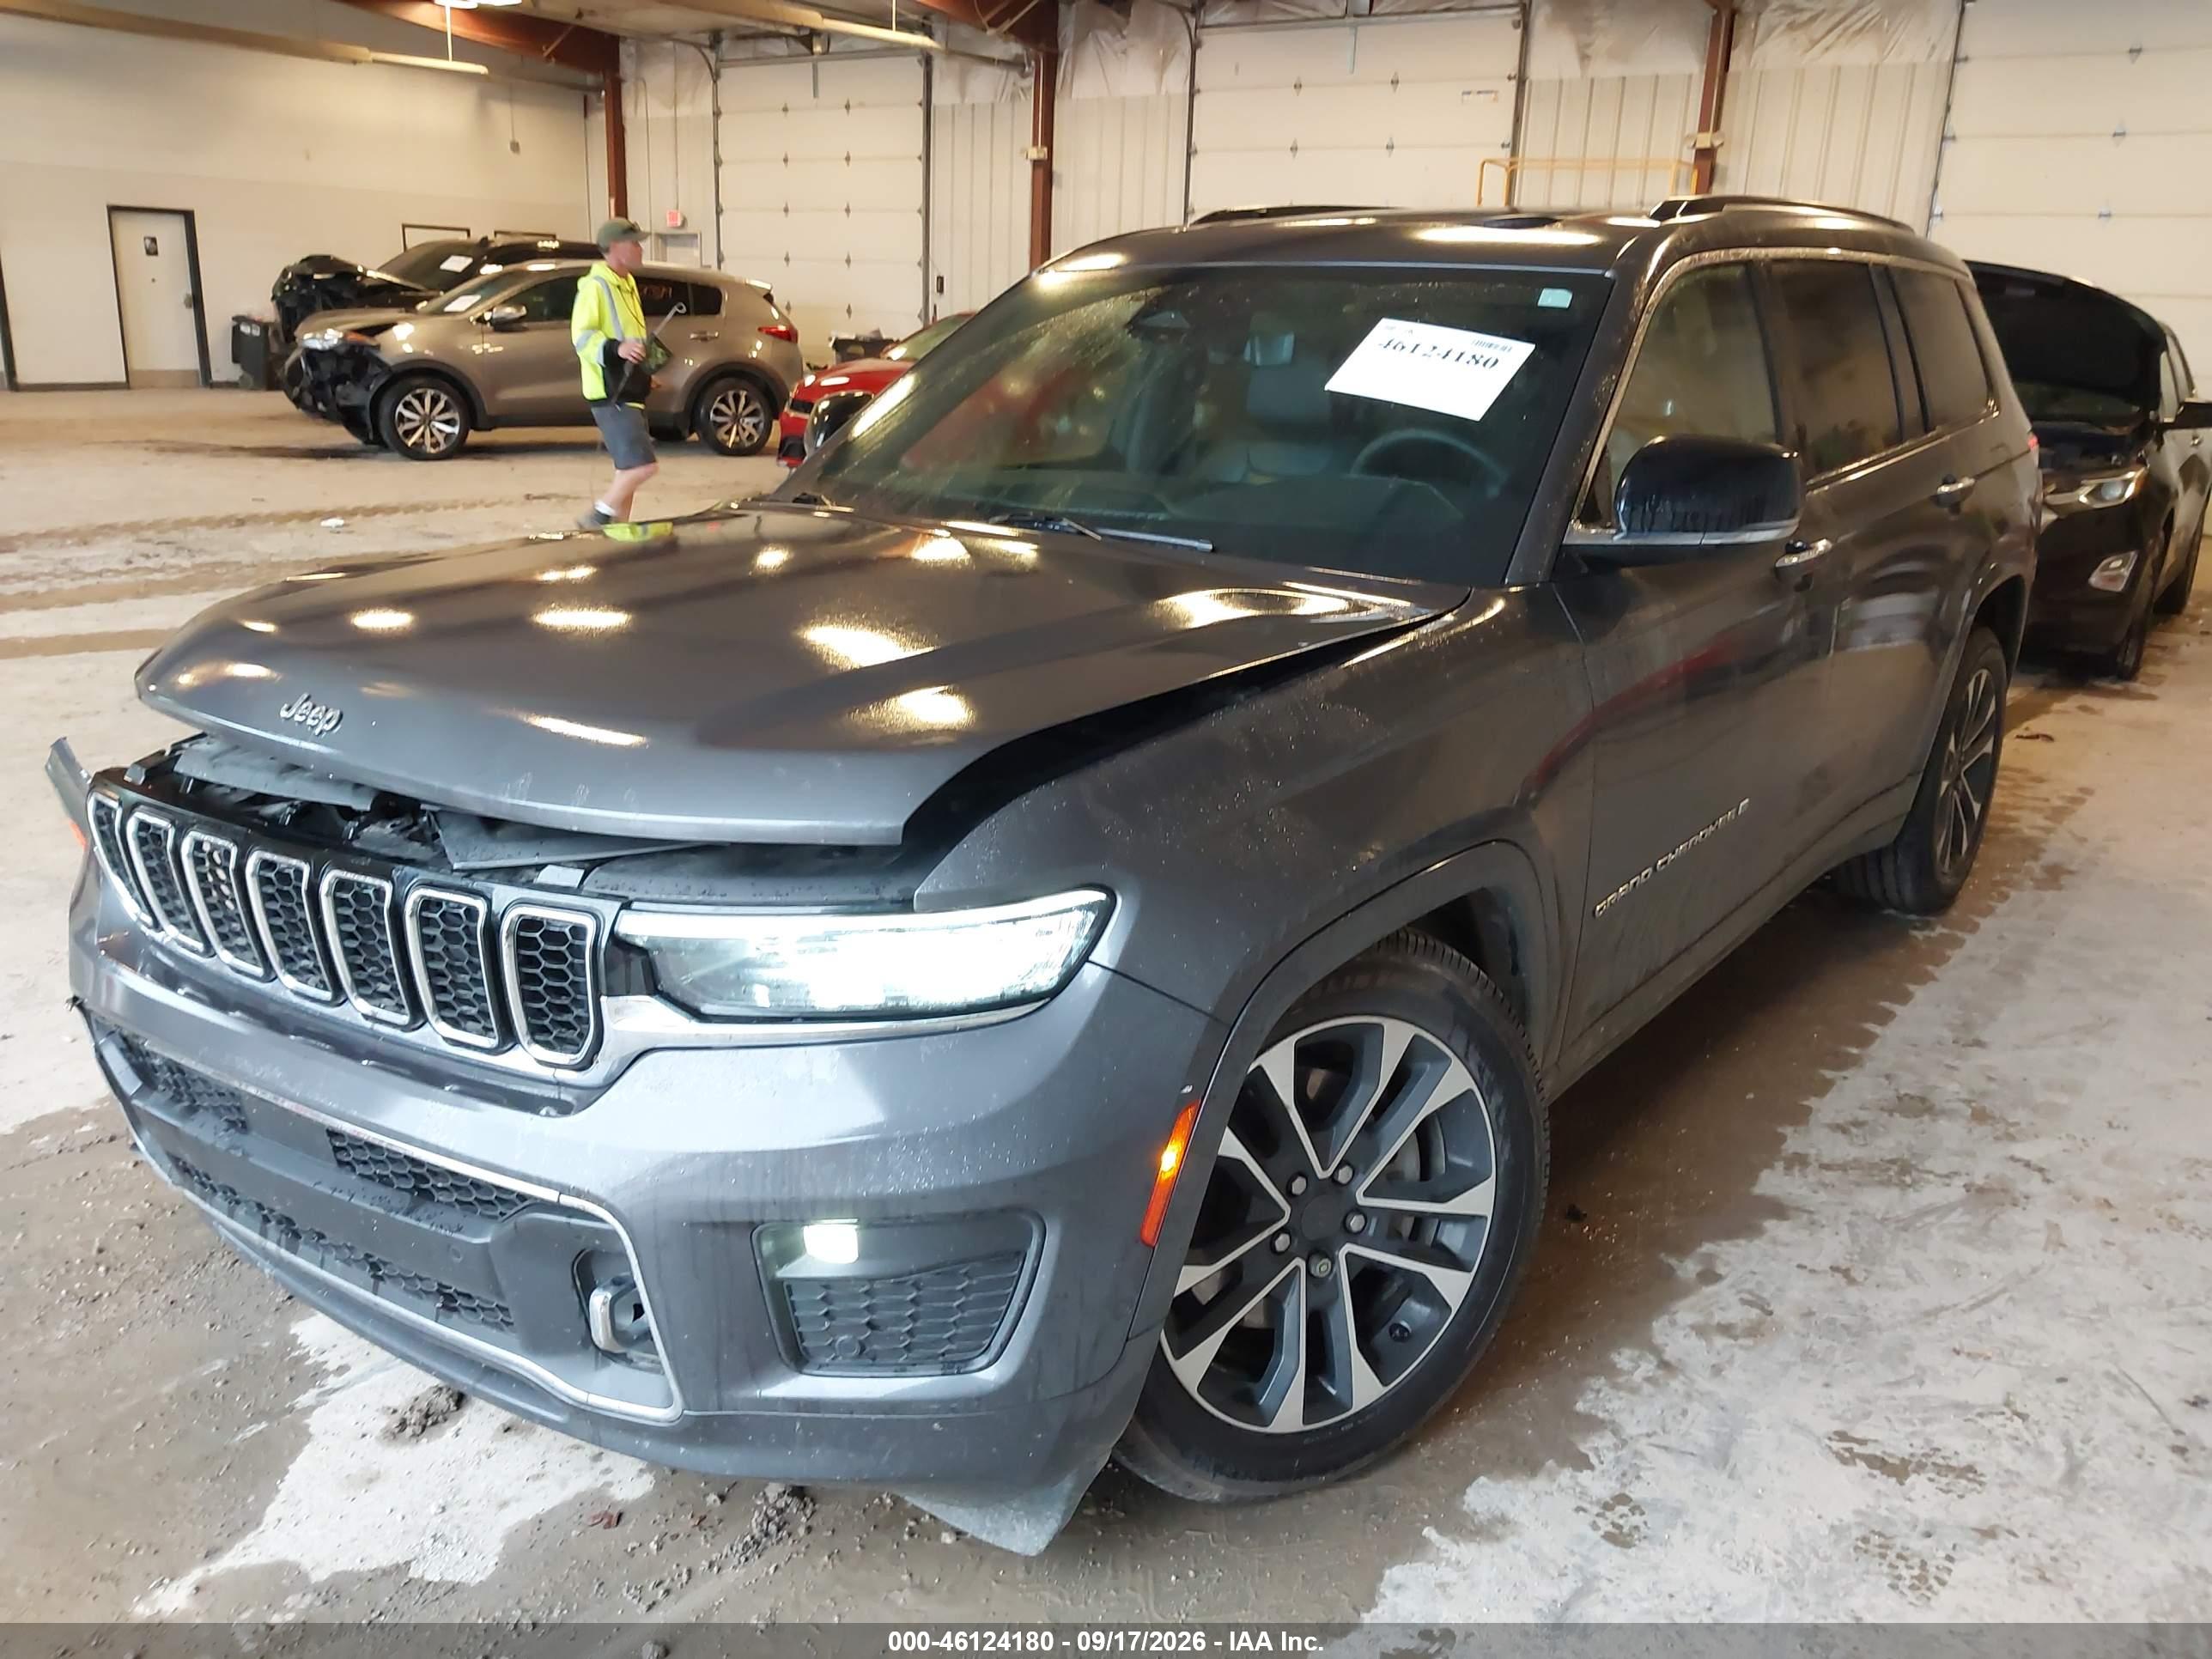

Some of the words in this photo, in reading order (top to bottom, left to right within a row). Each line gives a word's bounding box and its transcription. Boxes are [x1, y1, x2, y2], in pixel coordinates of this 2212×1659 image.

[1378, 338, 1499, 368] 46124180
[280, 692, 343, 736] Jeep
[1595, 866, 1653, 917] GRAND
